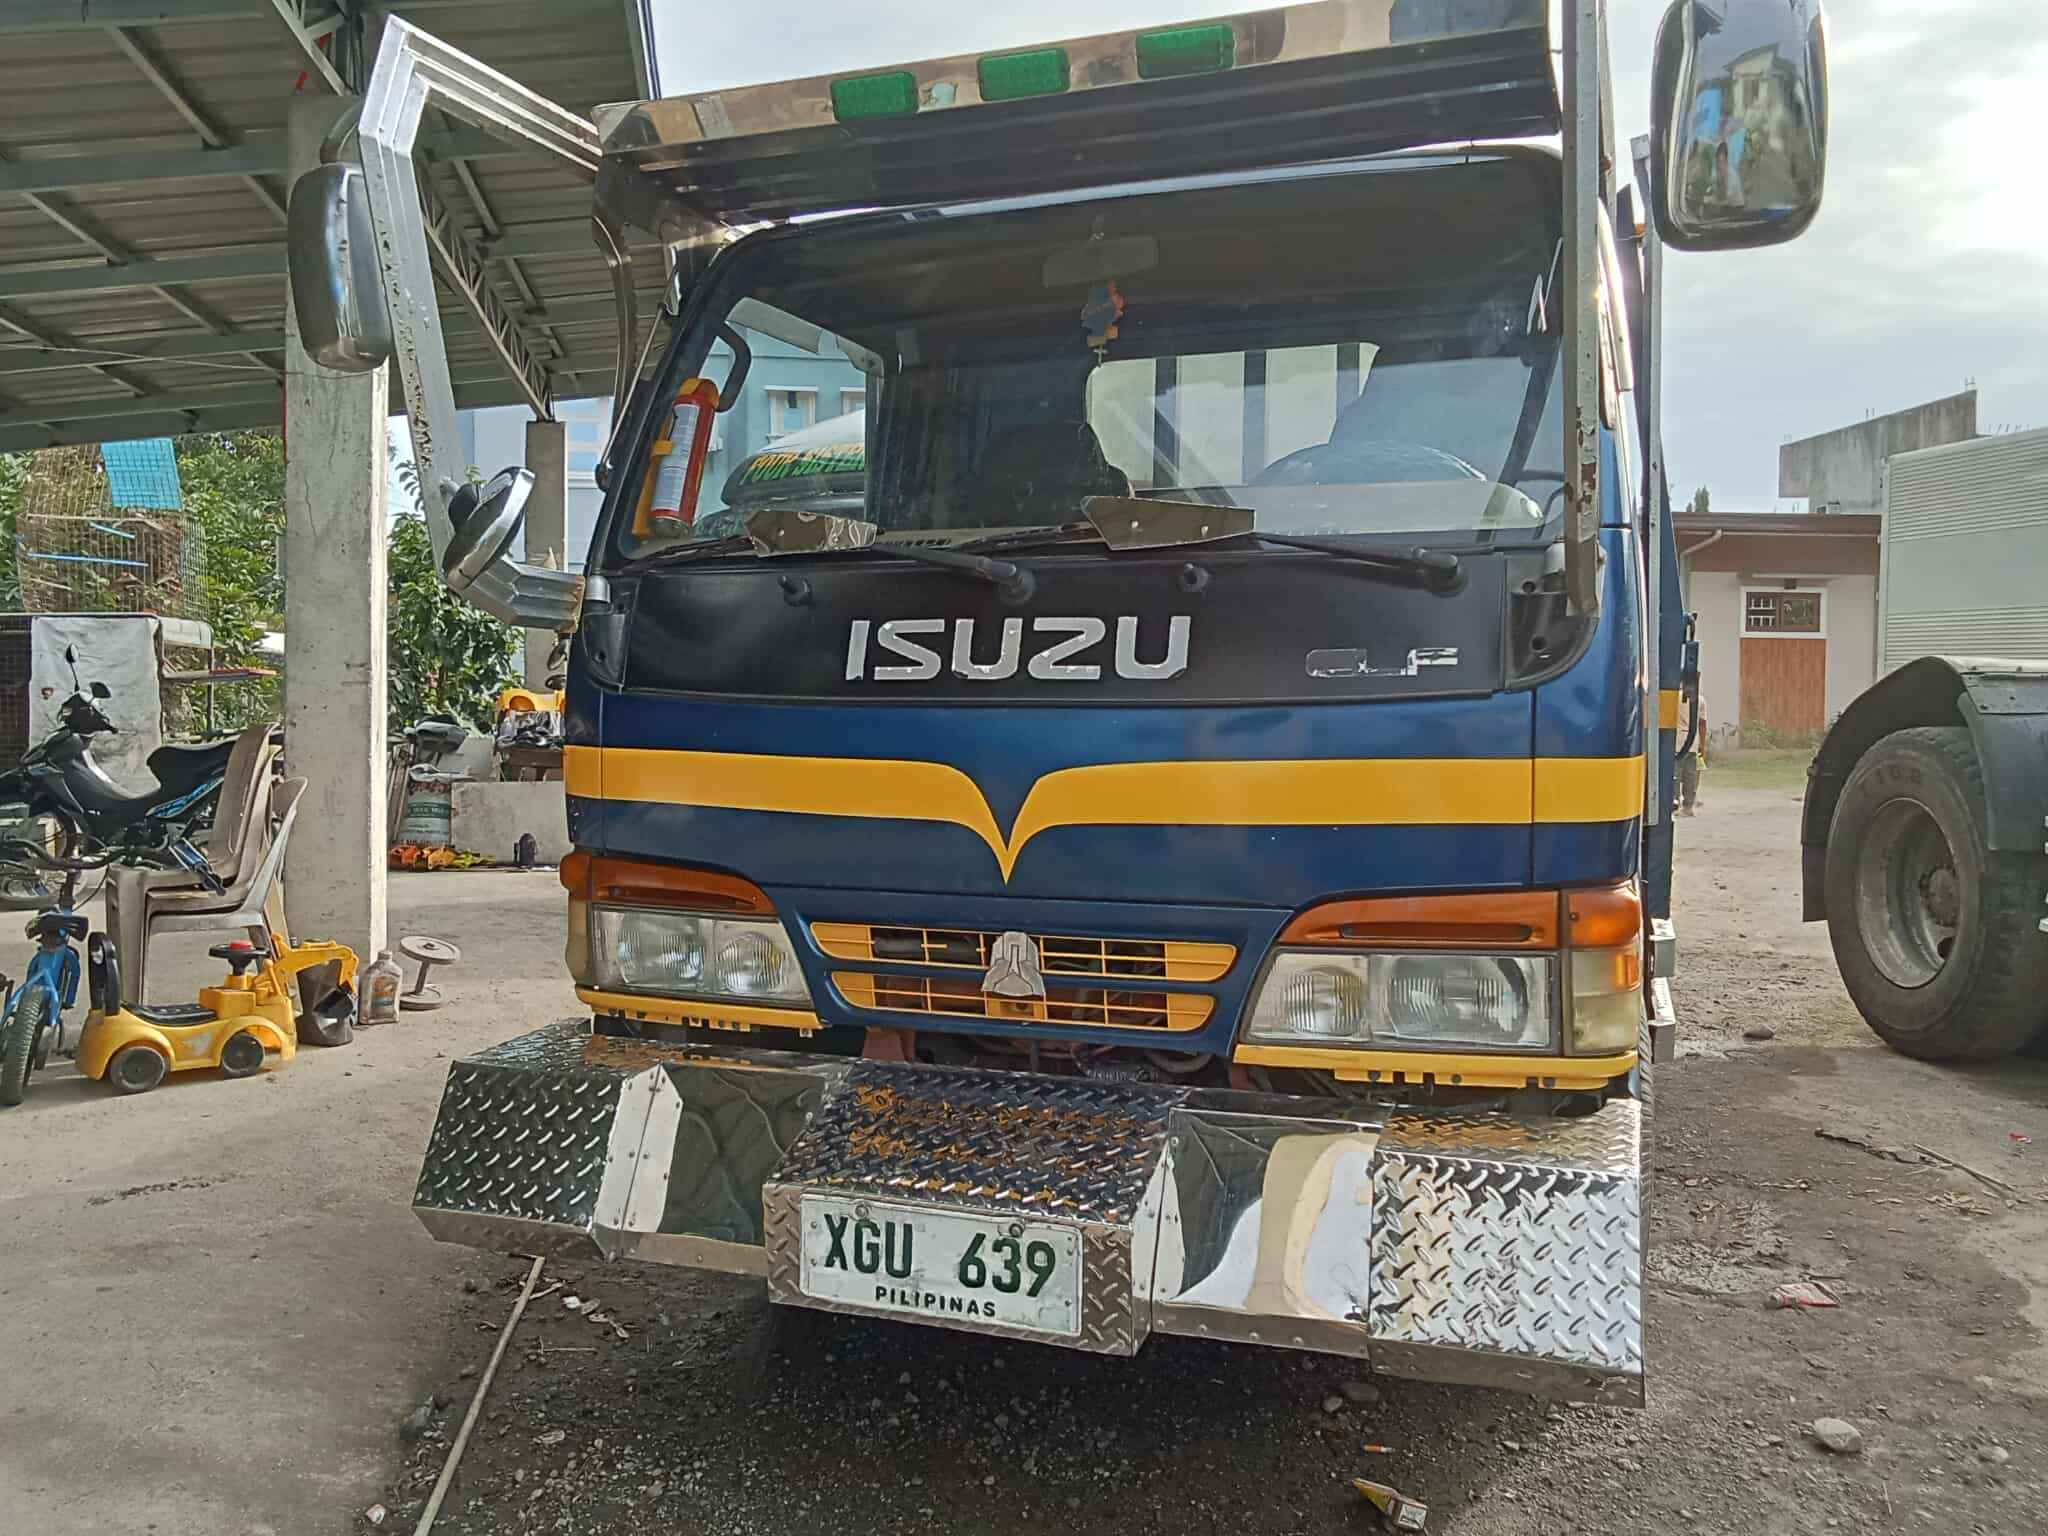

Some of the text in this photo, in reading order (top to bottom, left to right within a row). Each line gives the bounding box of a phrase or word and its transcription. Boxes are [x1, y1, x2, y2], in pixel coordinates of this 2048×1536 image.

[845, 615, 1192, 681] ISUZU
[823, 1213, 1056, 1298] XGU 639
[875, 1285, 996, 1318] PILIPINAS
